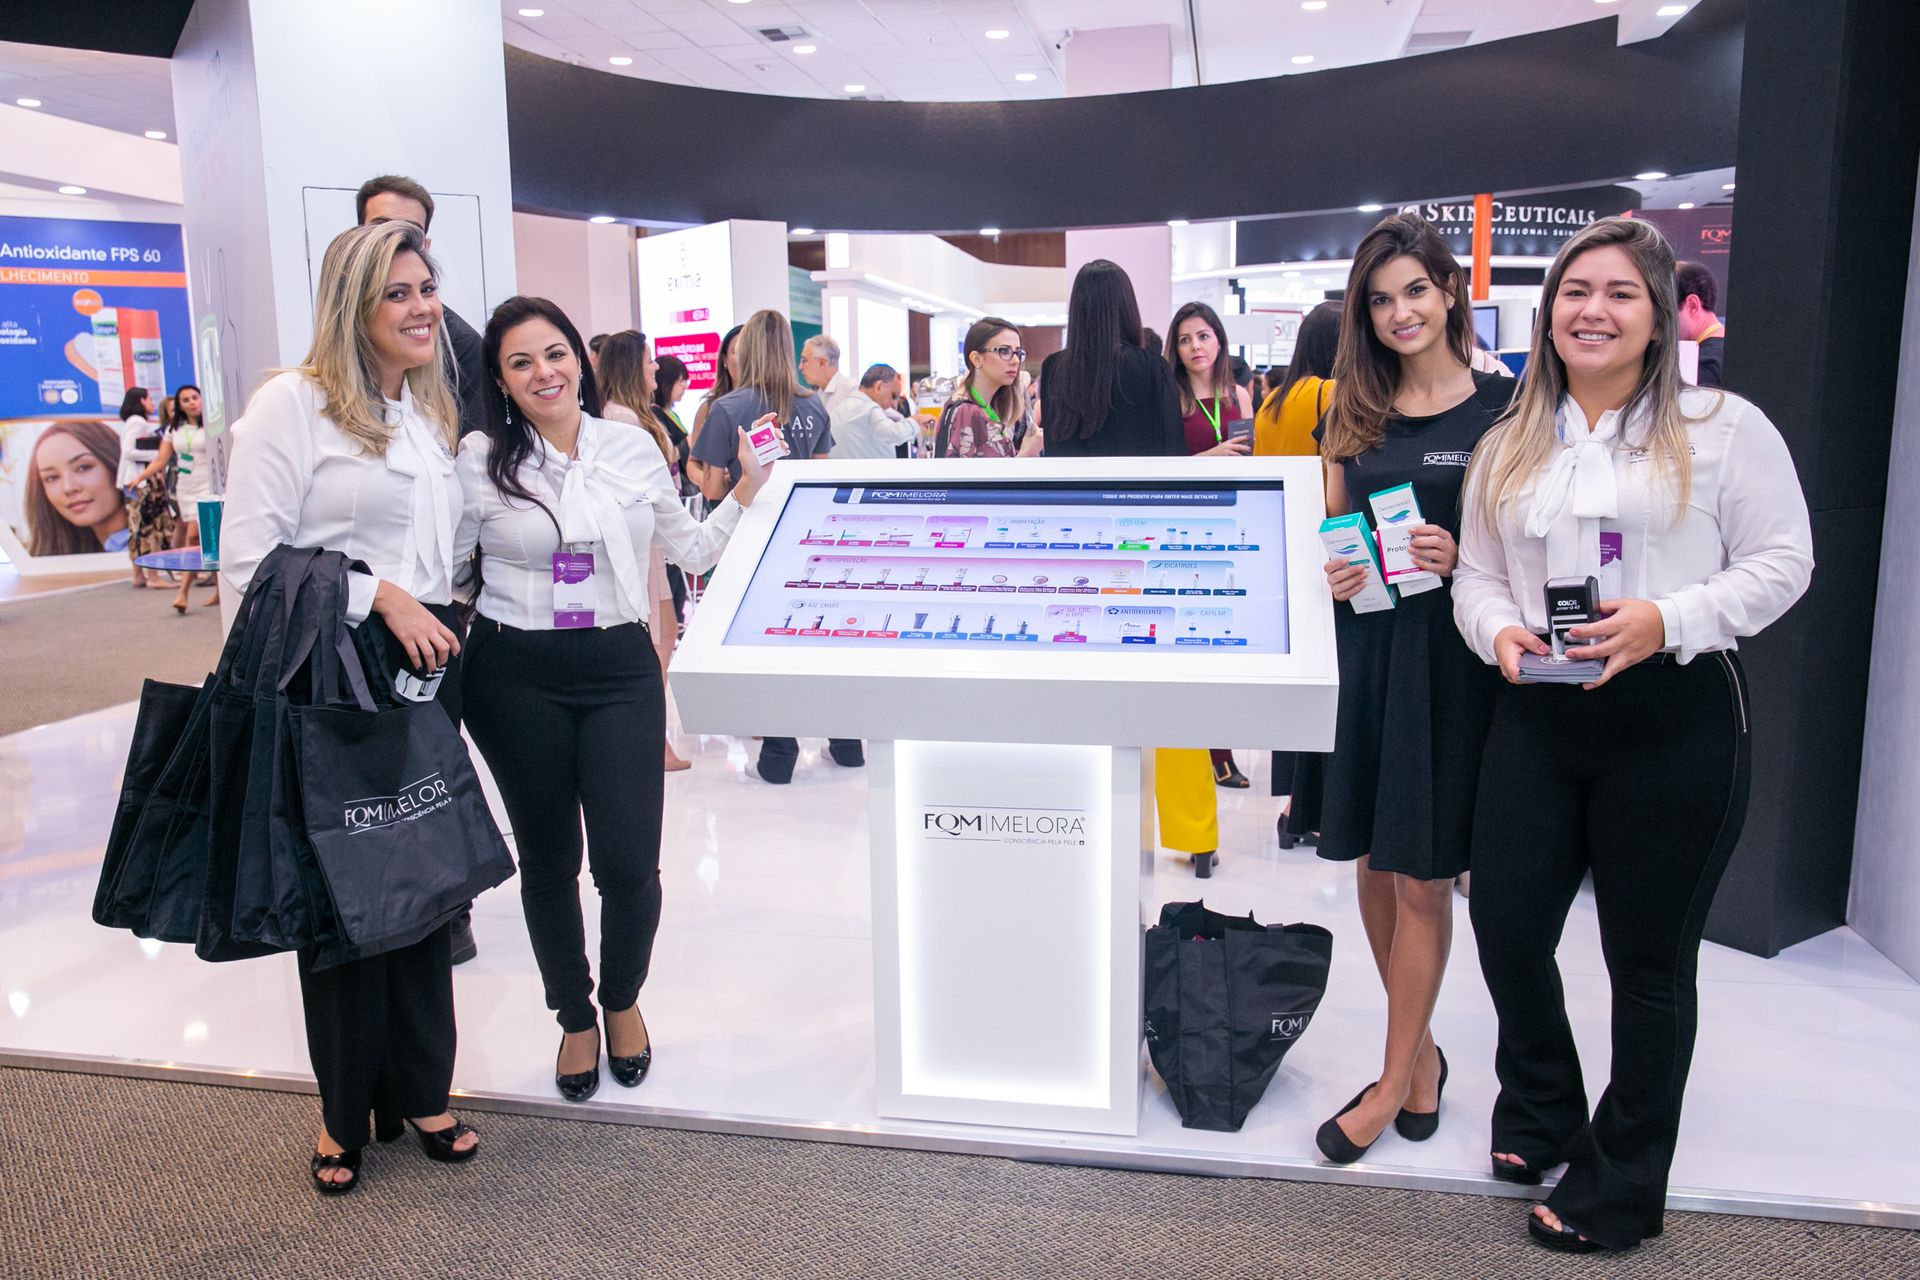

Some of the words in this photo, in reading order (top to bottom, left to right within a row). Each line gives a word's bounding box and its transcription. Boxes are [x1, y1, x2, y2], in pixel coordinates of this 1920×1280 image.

[0, 243, 108, 262] Antioxidante
[111, 246, 140, 263] FPS
[143, 248, 162, 263] 60
[344, 804, 382, 828] FQM
[924, 813, 982, 836] FQM
[991, 816, 1085, 834] MELORA
[1003, 836, 1046, 844] CONSCIÊNCIA
[1272, 1016, 1303, 1036] FQM
